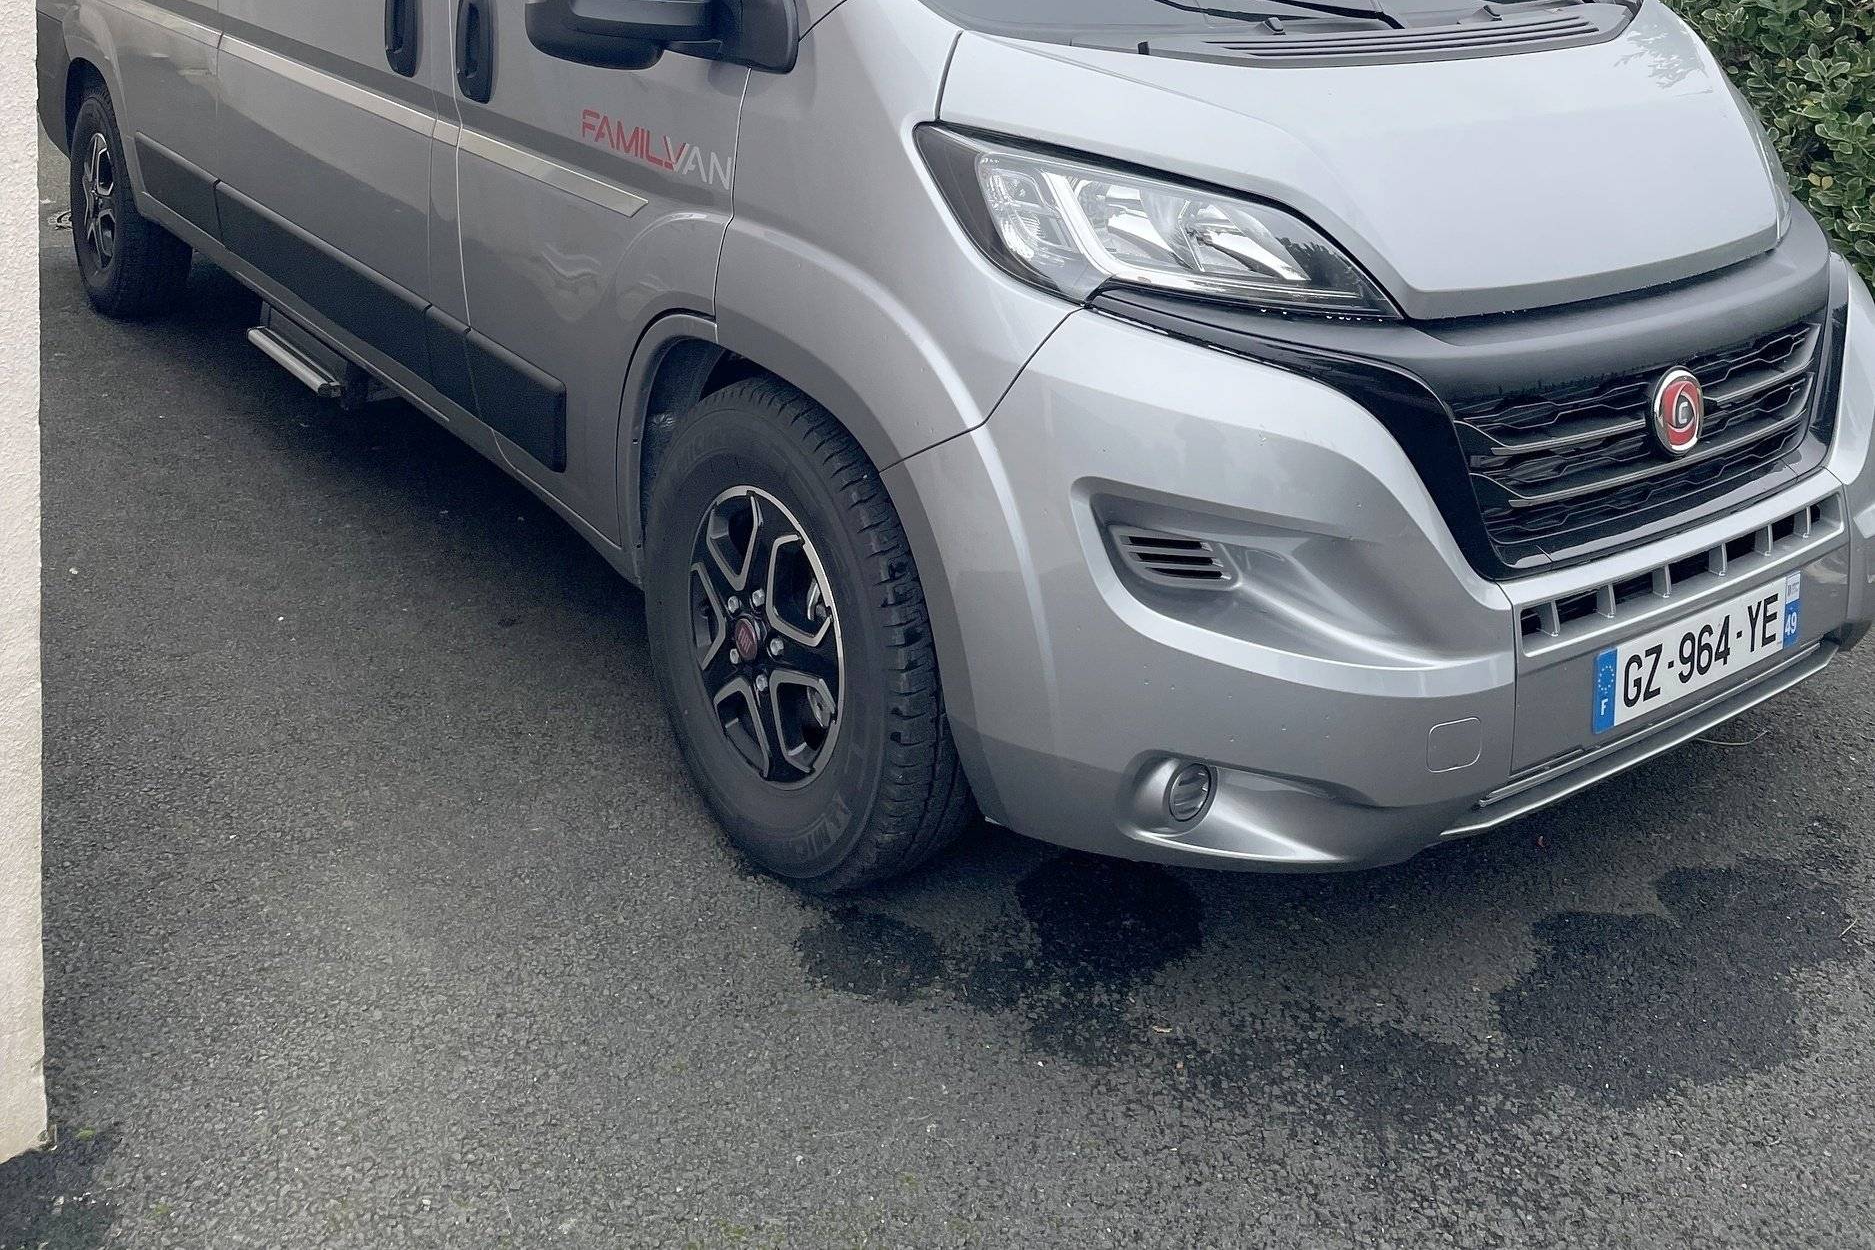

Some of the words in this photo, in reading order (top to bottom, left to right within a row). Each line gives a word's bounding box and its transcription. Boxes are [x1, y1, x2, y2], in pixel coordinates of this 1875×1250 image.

[1784, 611, 1798, 636] 49
[1623, 593, 1779, 708] GZ-964-YE
[1599, 698, 1609, 716] F
